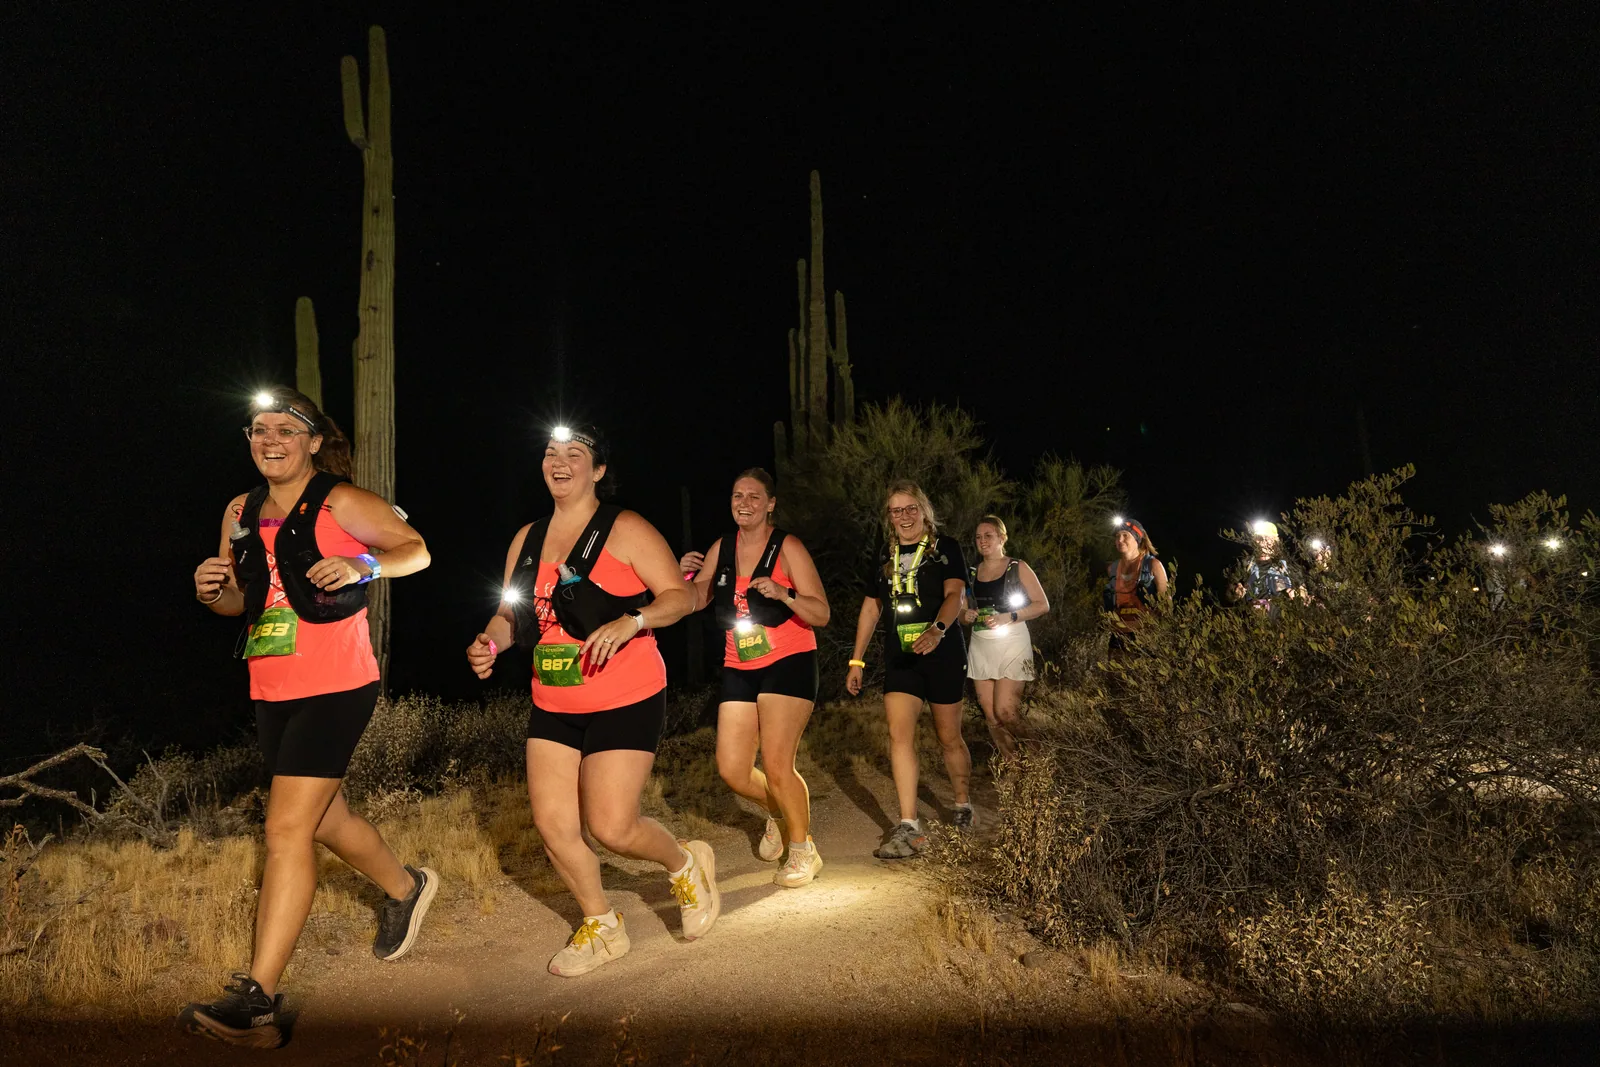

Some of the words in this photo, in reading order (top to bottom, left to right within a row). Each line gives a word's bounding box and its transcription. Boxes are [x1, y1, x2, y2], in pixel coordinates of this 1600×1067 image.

[738, 634, 763, 649] 884
[904, 632, 921, 642] 88
[541, 657, 574, 671] 887
